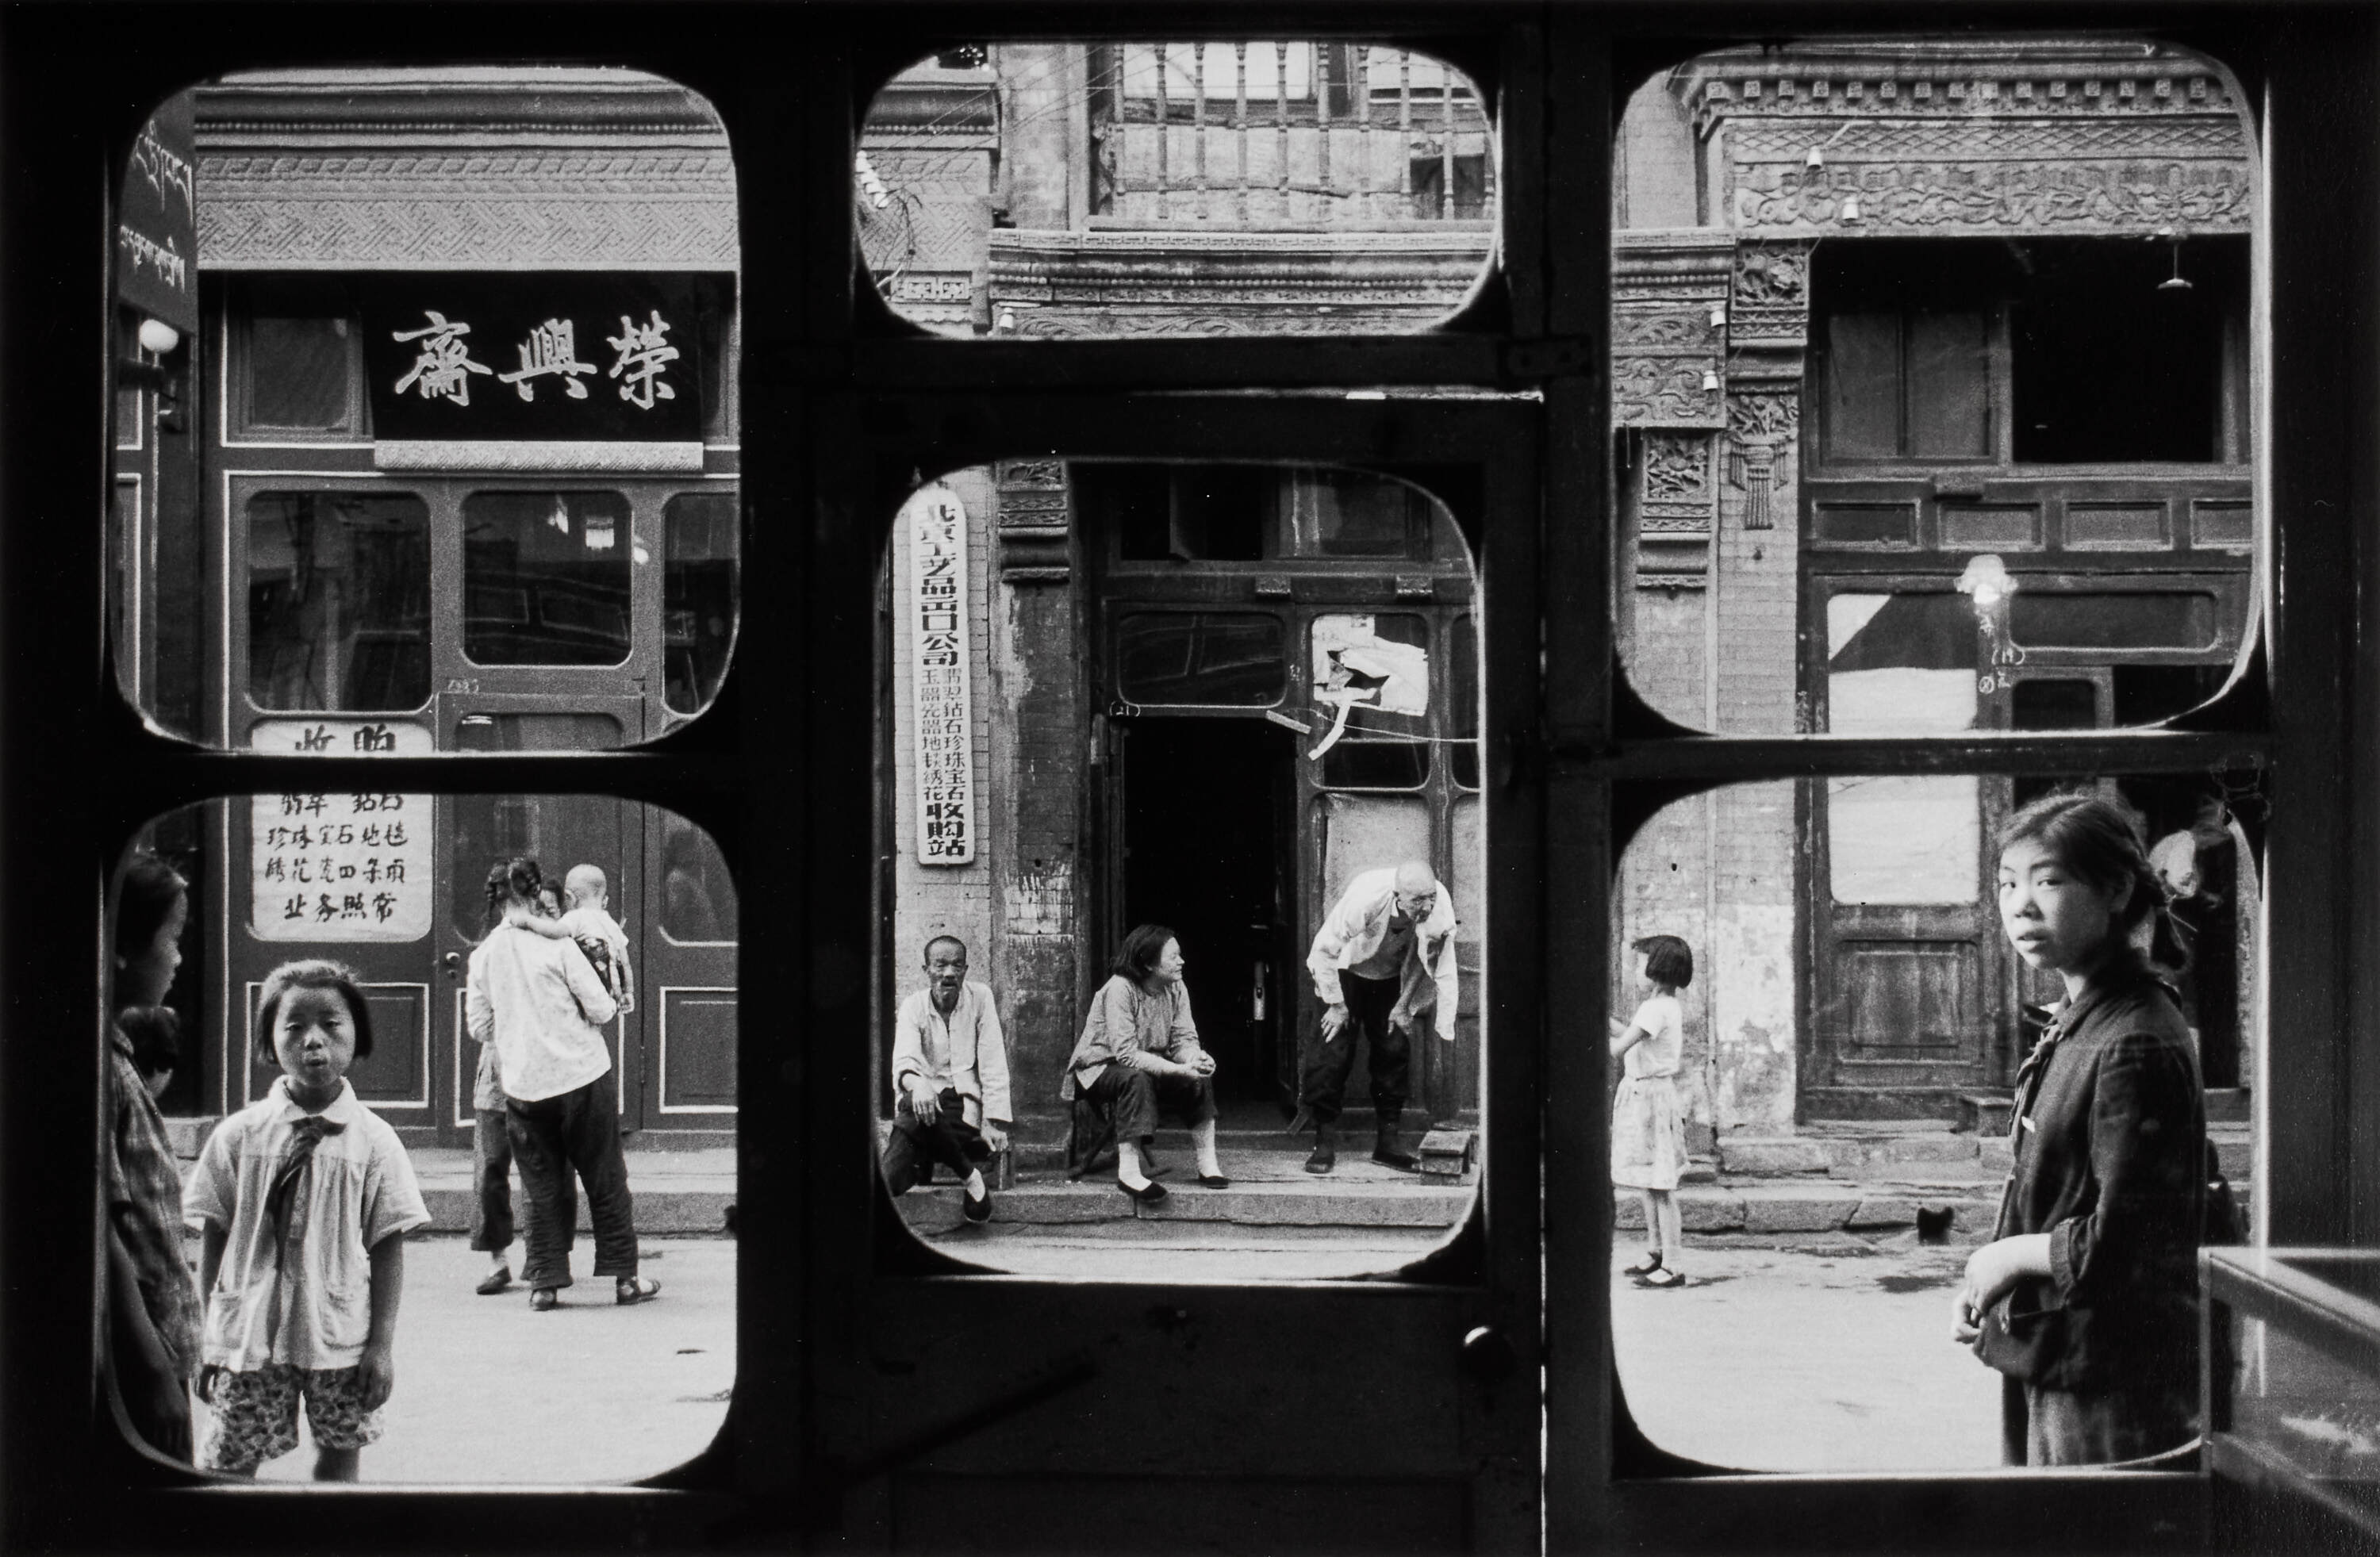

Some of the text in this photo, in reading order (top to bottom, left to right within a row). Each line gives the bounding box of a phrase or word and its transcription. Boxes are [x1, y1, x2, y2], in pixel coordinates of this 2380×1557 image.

[926, 802, 966, 857] 收购站
[284, 892, 397, 923] 业务照常
